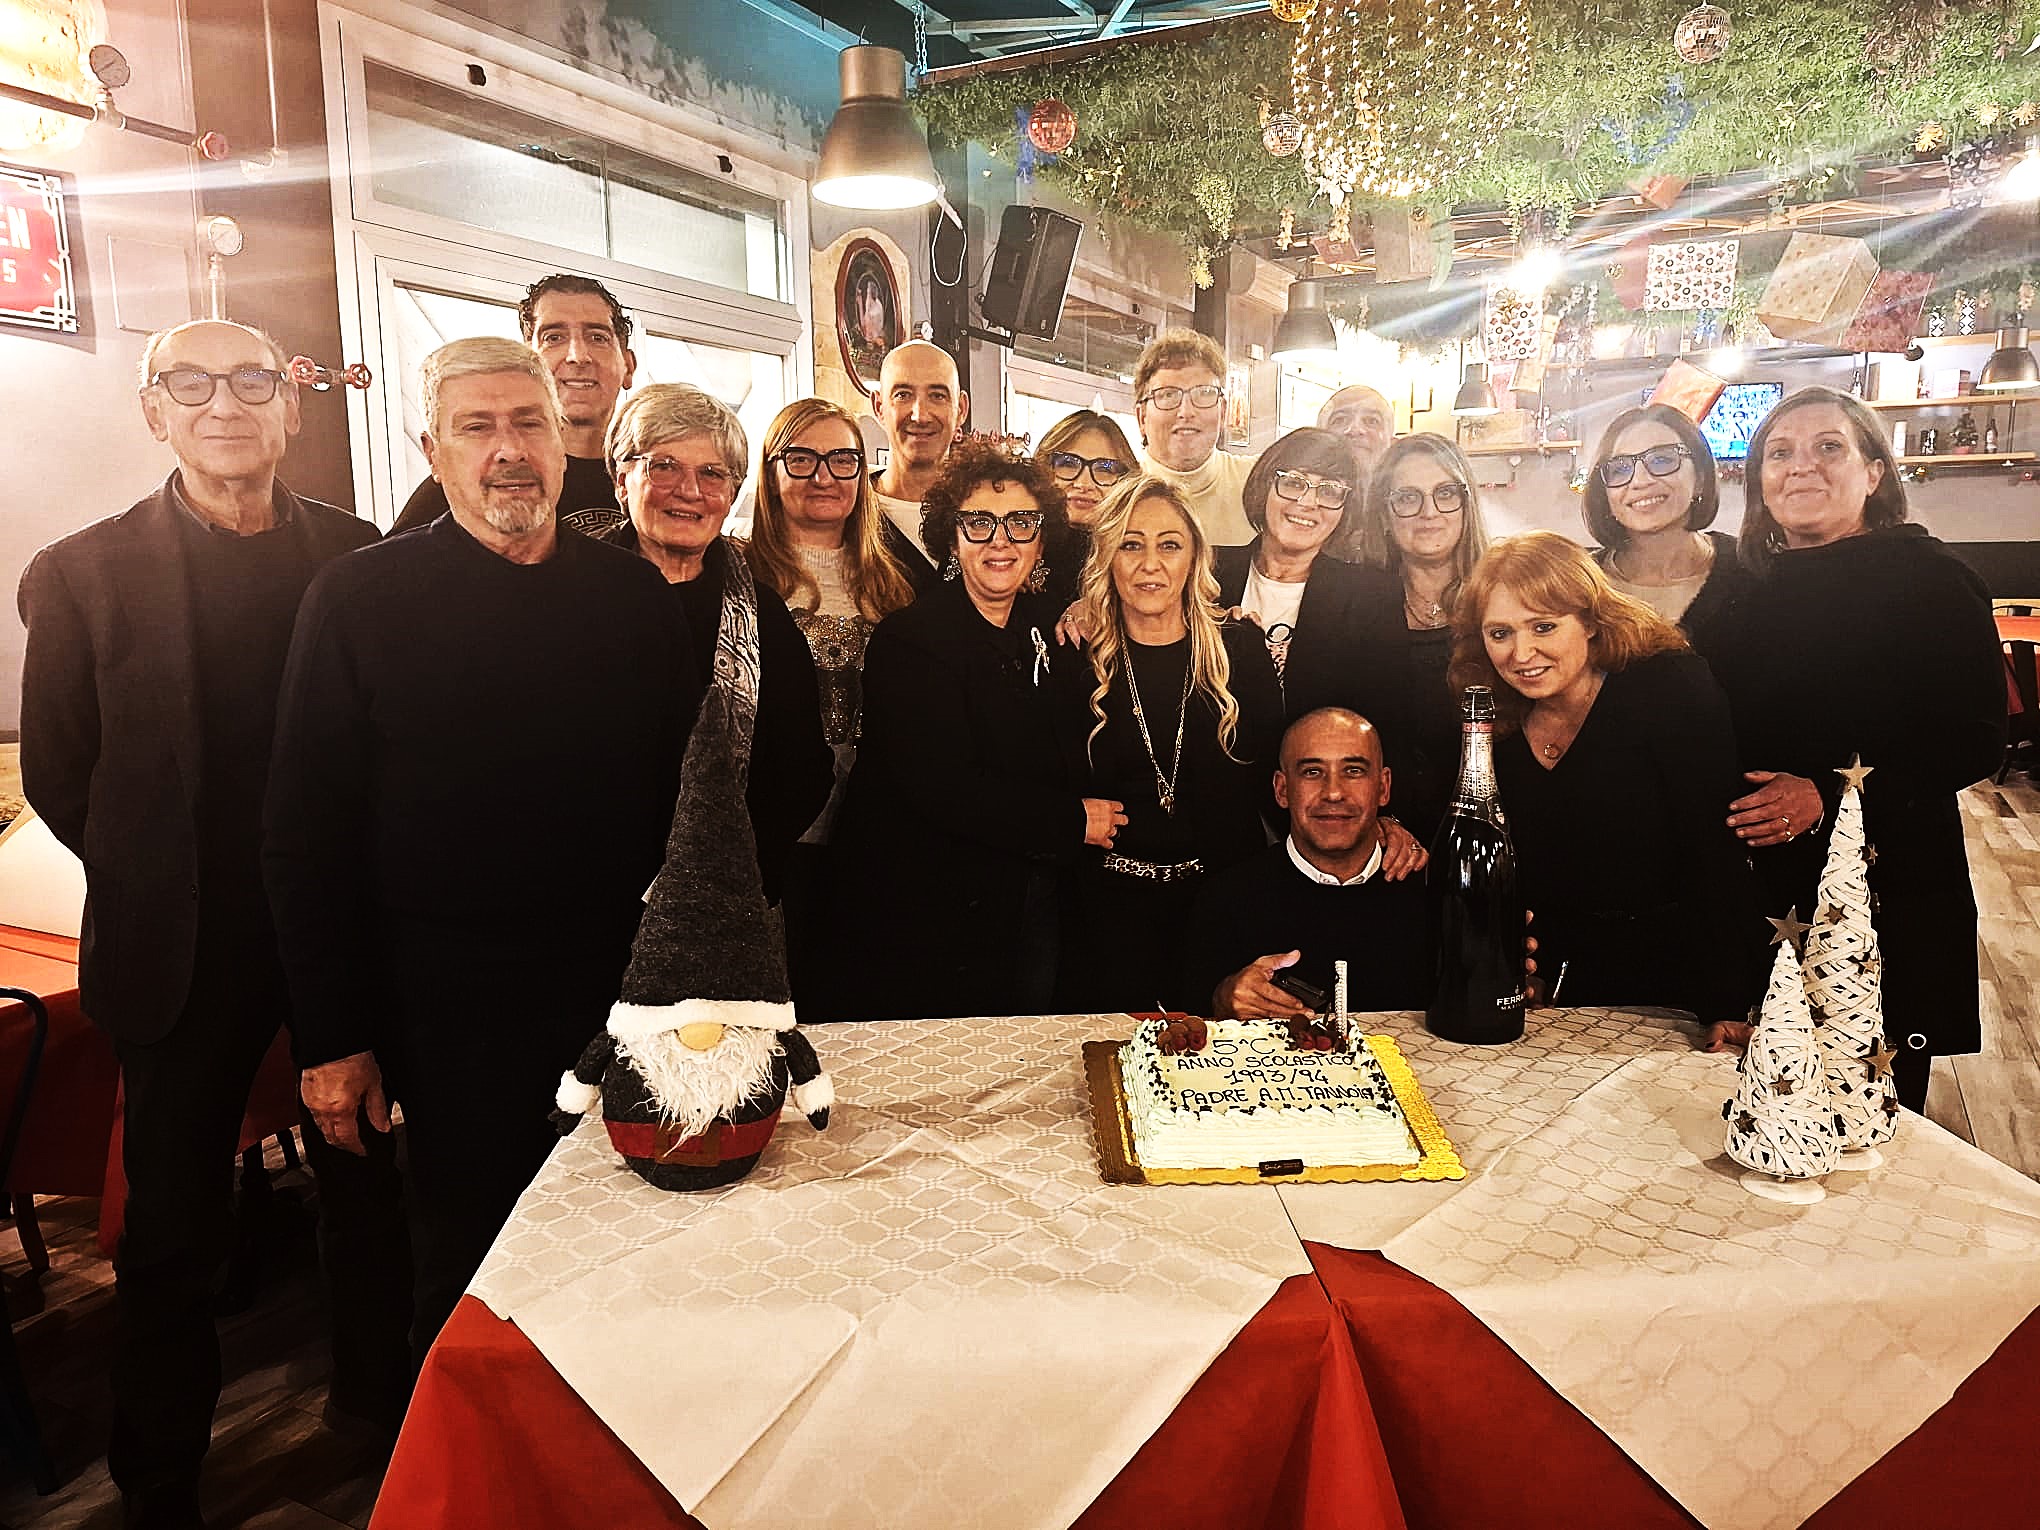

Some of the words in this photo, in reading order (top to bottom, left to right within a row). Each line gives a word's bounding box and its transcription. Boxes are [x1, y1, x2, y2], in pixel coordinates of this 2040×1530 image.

[1177, 1056, 1235, 1070] ANNO
[1245, 1055, 1354, 1068] SCOLASTICO
[1223, 1068, 1329, 1085] 1993/94
[1180, 1088, 1249, 1109] PADRE
